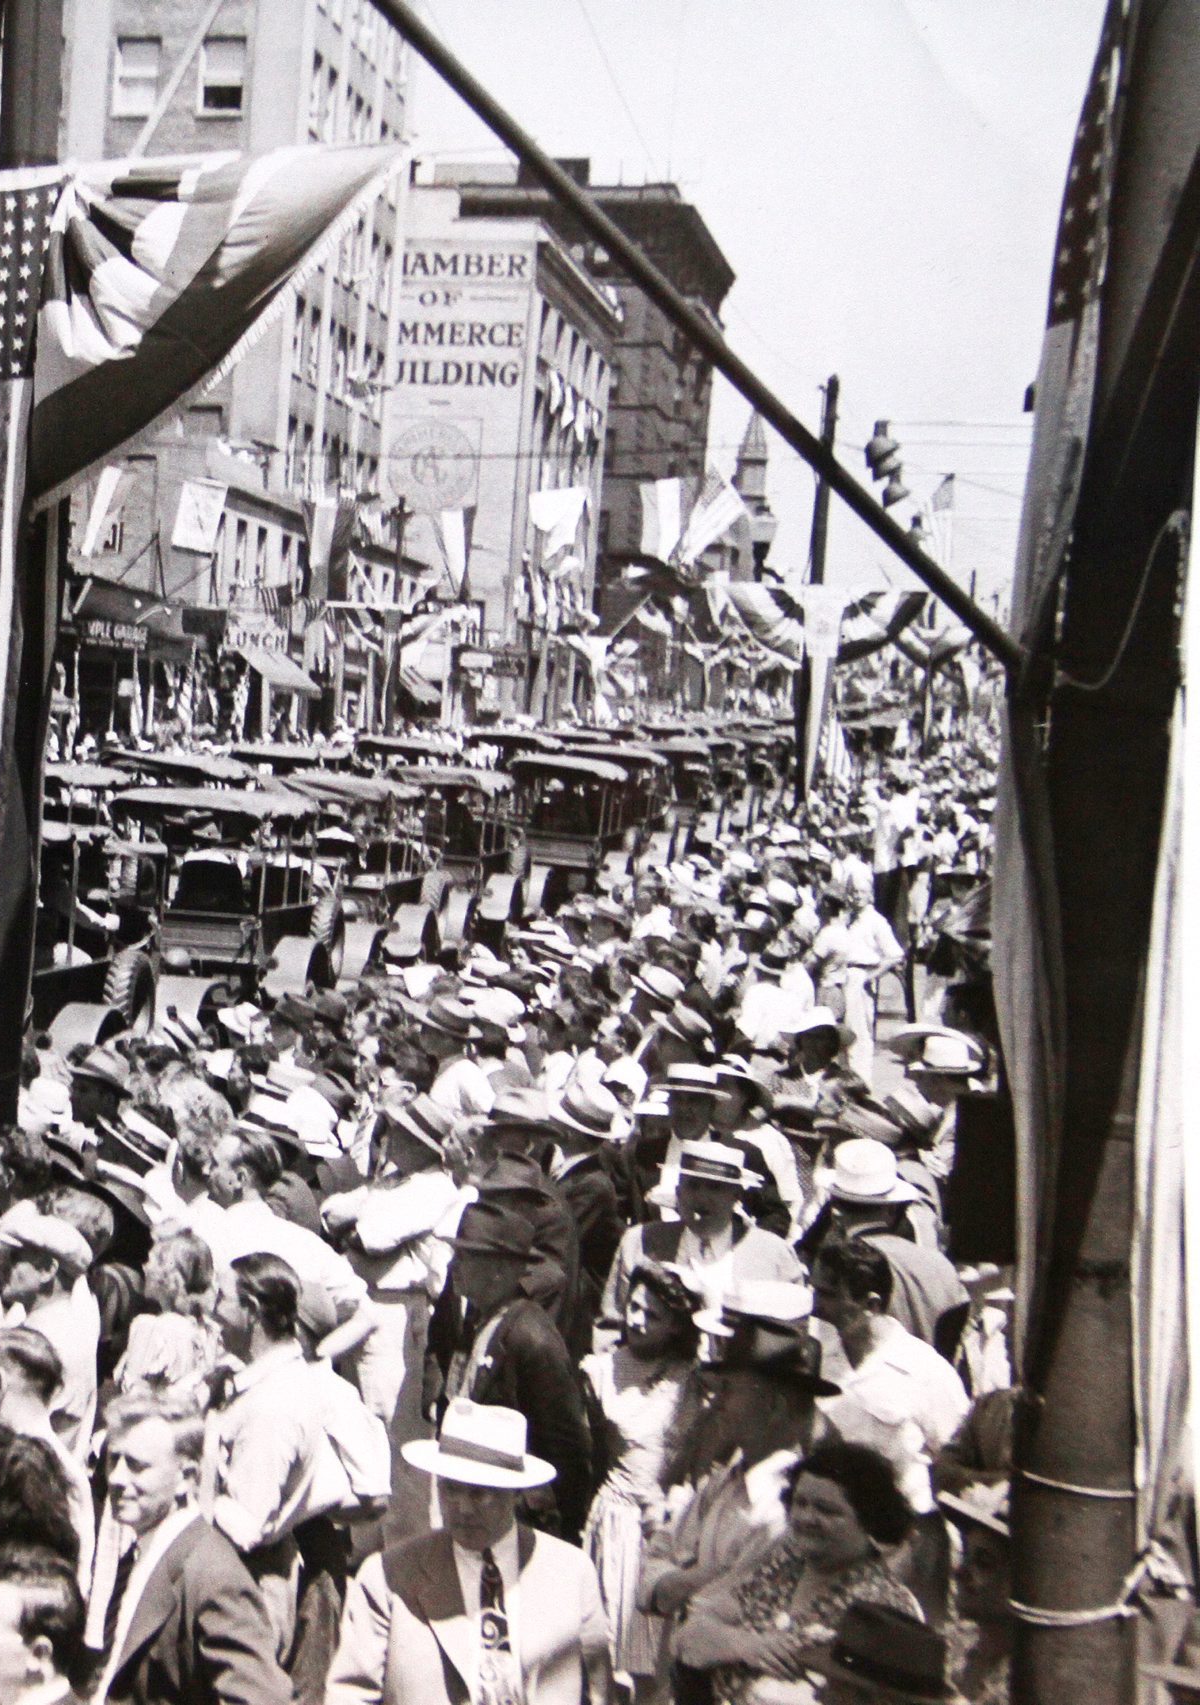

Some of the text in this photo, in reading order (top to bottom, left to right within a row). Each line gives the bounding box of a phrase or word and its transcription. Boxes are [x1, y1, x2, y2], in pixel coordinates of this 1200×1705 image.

[403, 252, 527, 278] AMBER
[418, 290, 462, 307] OF
[397, 321, 524, 347] MMERCE
[395, 360, 519, 388] ILDING
[225, 629, 285, 653] LUNCH
